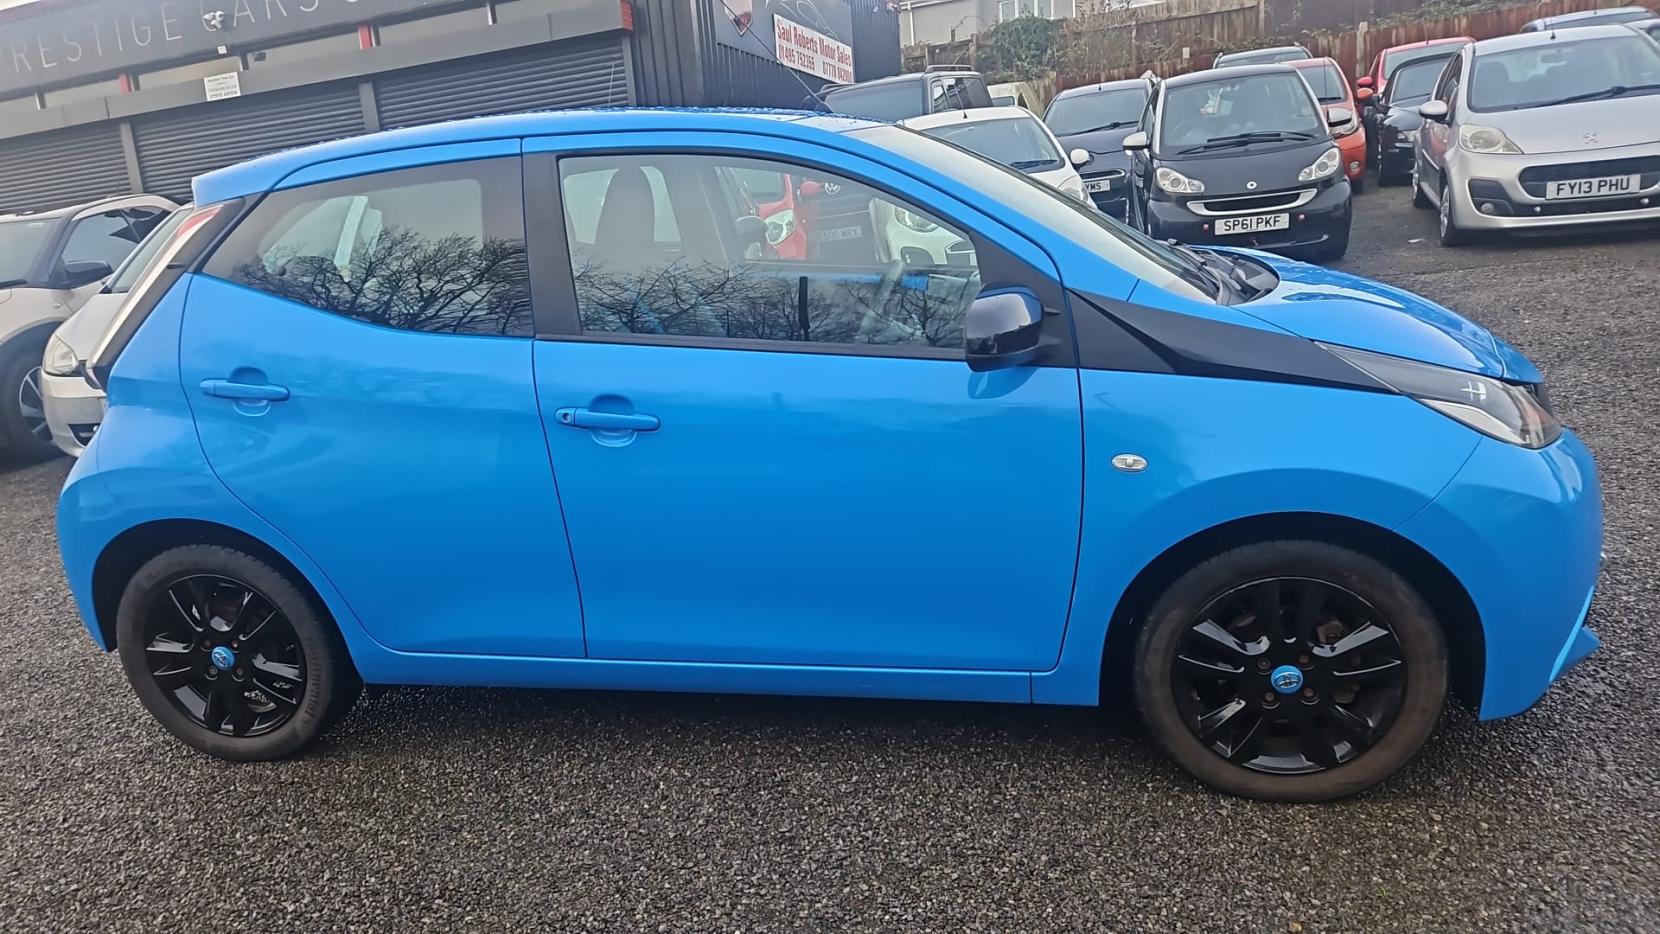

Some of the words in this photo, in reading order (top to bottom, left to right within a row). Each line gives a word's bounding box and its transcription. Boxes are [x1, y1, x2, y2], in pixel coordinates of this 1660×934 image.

[0, 3, 183, 74] RESTIGE
[777, 18, 793, 43] Saul
[794, 26, 818, 55] Roberts
[818, 37, 836, 61] Motor
[837, 45, 852, 67] Sales
[778, 43, 796, 65] 01495
[1556, 181, 1593, 197] FY13
[1597, 177, 1630, 193] PHU
[1223, 218, 1253, 232] SP61
[1255, 215, 1281, 229] PKF
